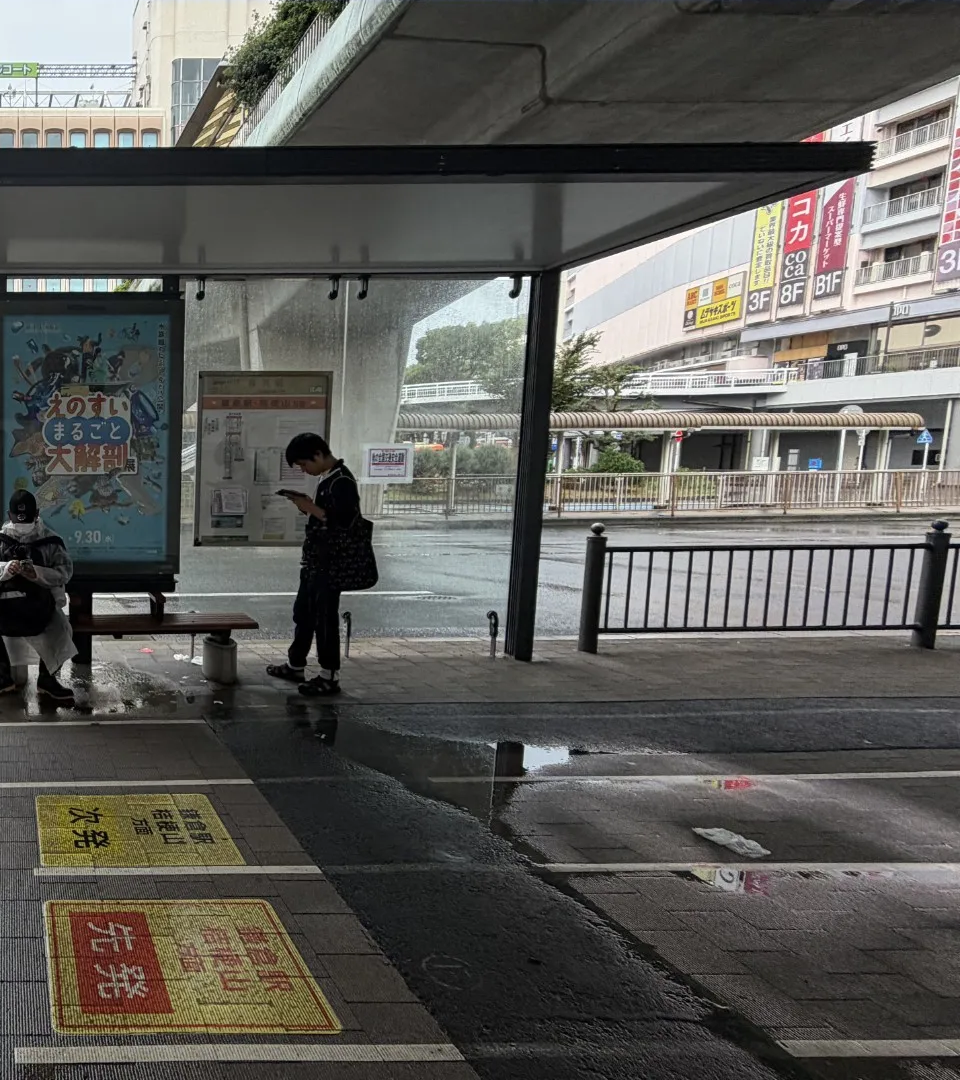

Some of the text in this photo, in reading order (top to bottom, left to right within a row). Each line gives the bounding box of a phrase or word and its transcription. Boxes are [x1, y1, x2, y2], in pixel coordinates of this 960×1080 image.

[788, 198, 811, 245] コカ
[822, 205, 836, 268] スーパーマーケット
[784, 250, 807, 264] co
[784, 263, 806, 278] ca
[939, 248, 960, 274] 3
[780, 282, 805, 305] 8F
[815, 272, 842, 295] B1F
[748, 290, 771, 311] 3F
[47, 393, 129, 418] えのすい
[54, 422, 121, 441] まるごと
[47, 443, 136, 472] 大解剖展
[74, 530, 102, 544] 9.30
[68, 807, 111, 849] 次発
[131, 817, 154, 836] 方面
[150, 808, 187, 845] 桔梗山
[179, 808, 216, 845] 鎌倉駅
[87, 921, 149, 1000] 先発
[176, 944, 206, 973] 方面
[199, 926, 251, 992] 桔梗山
[236, 926, 295, 992] 鎌倉駅
